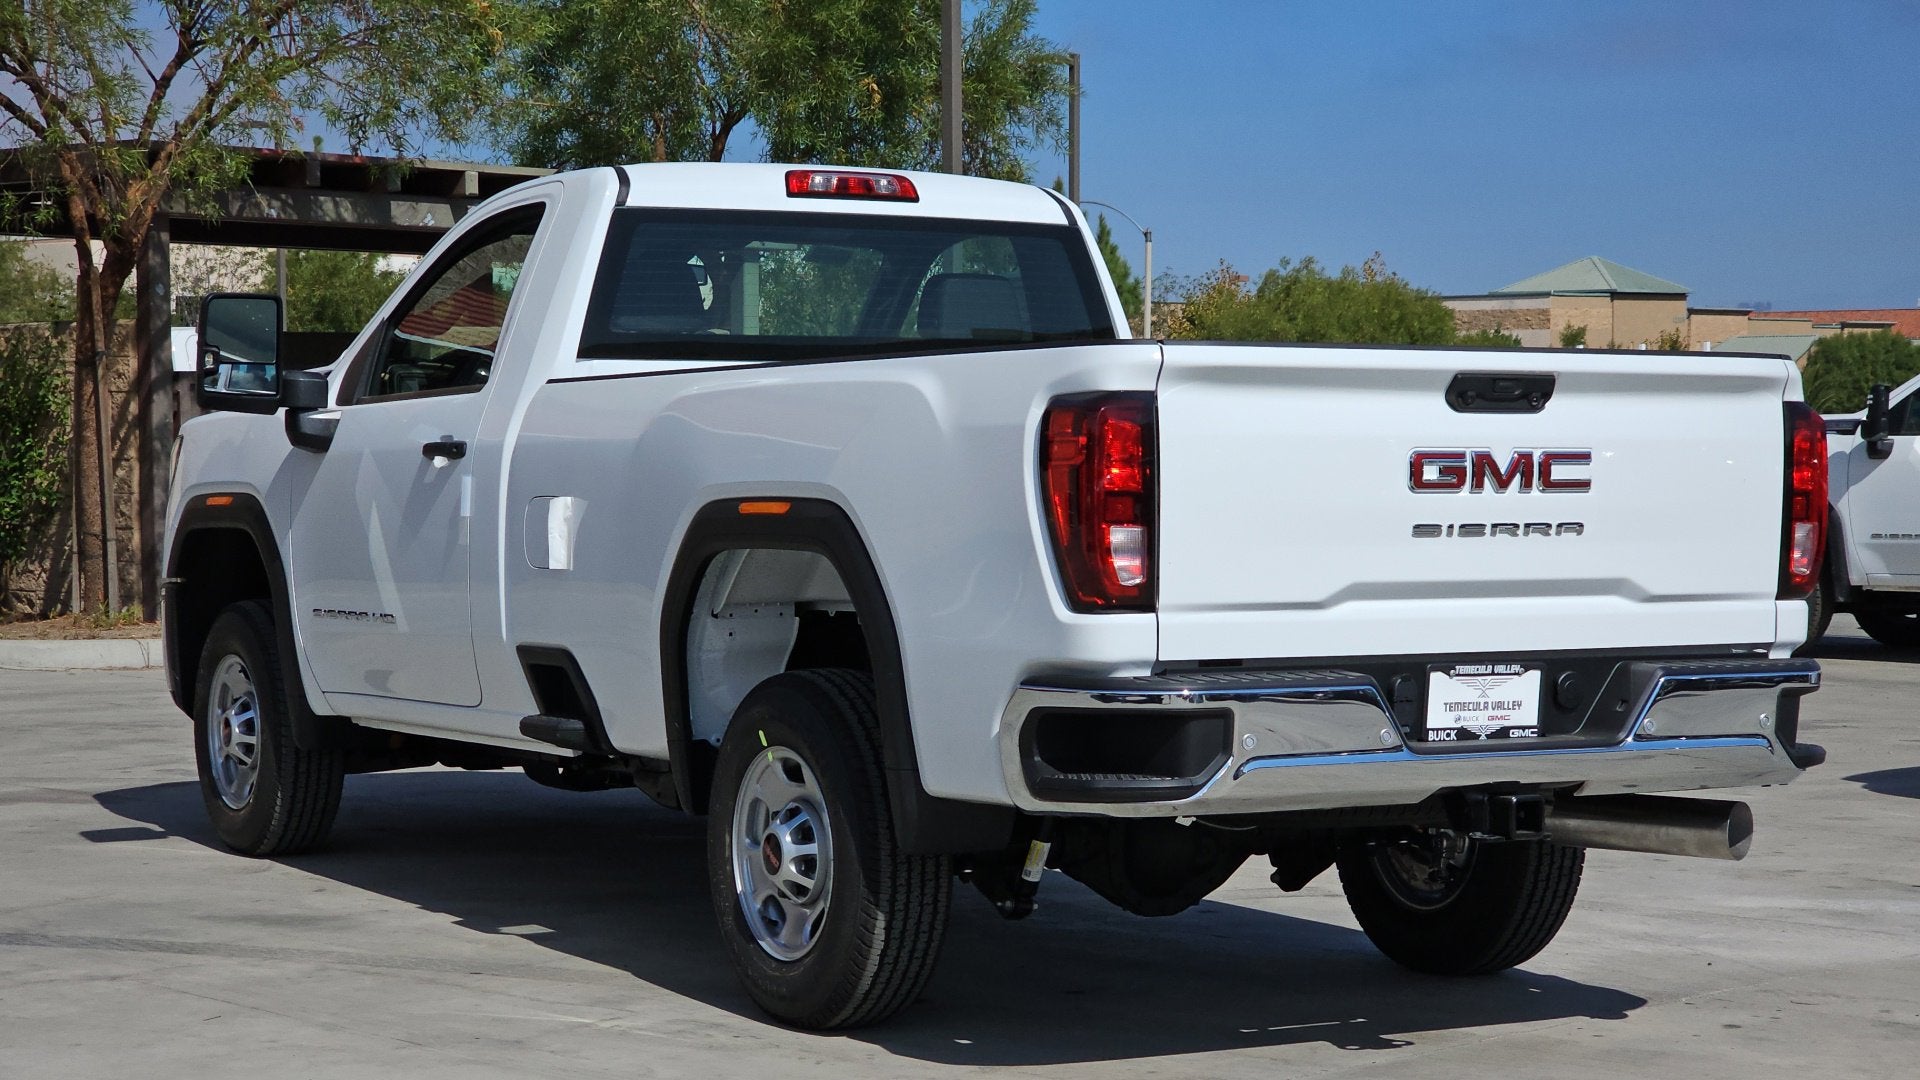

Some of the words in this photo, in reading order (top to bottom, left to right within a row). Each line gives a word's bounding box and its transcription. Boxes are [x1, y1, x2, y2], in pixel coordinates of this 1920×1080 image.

[1408, 447, 1592, 493] GMC
[1411, 522, 1585, 538] SIERRA
[1455, 665, 1492, 674] TEMECULA
[1494, 664, 1520, 673] VALLEY
[1443, 701, 1489, 712] TEMECULA
[1491, 700, 1522, 711] VALLEY
[1428, 730, 1457, 741] BUICK
[1509, 729, 1538, 738] GMC
